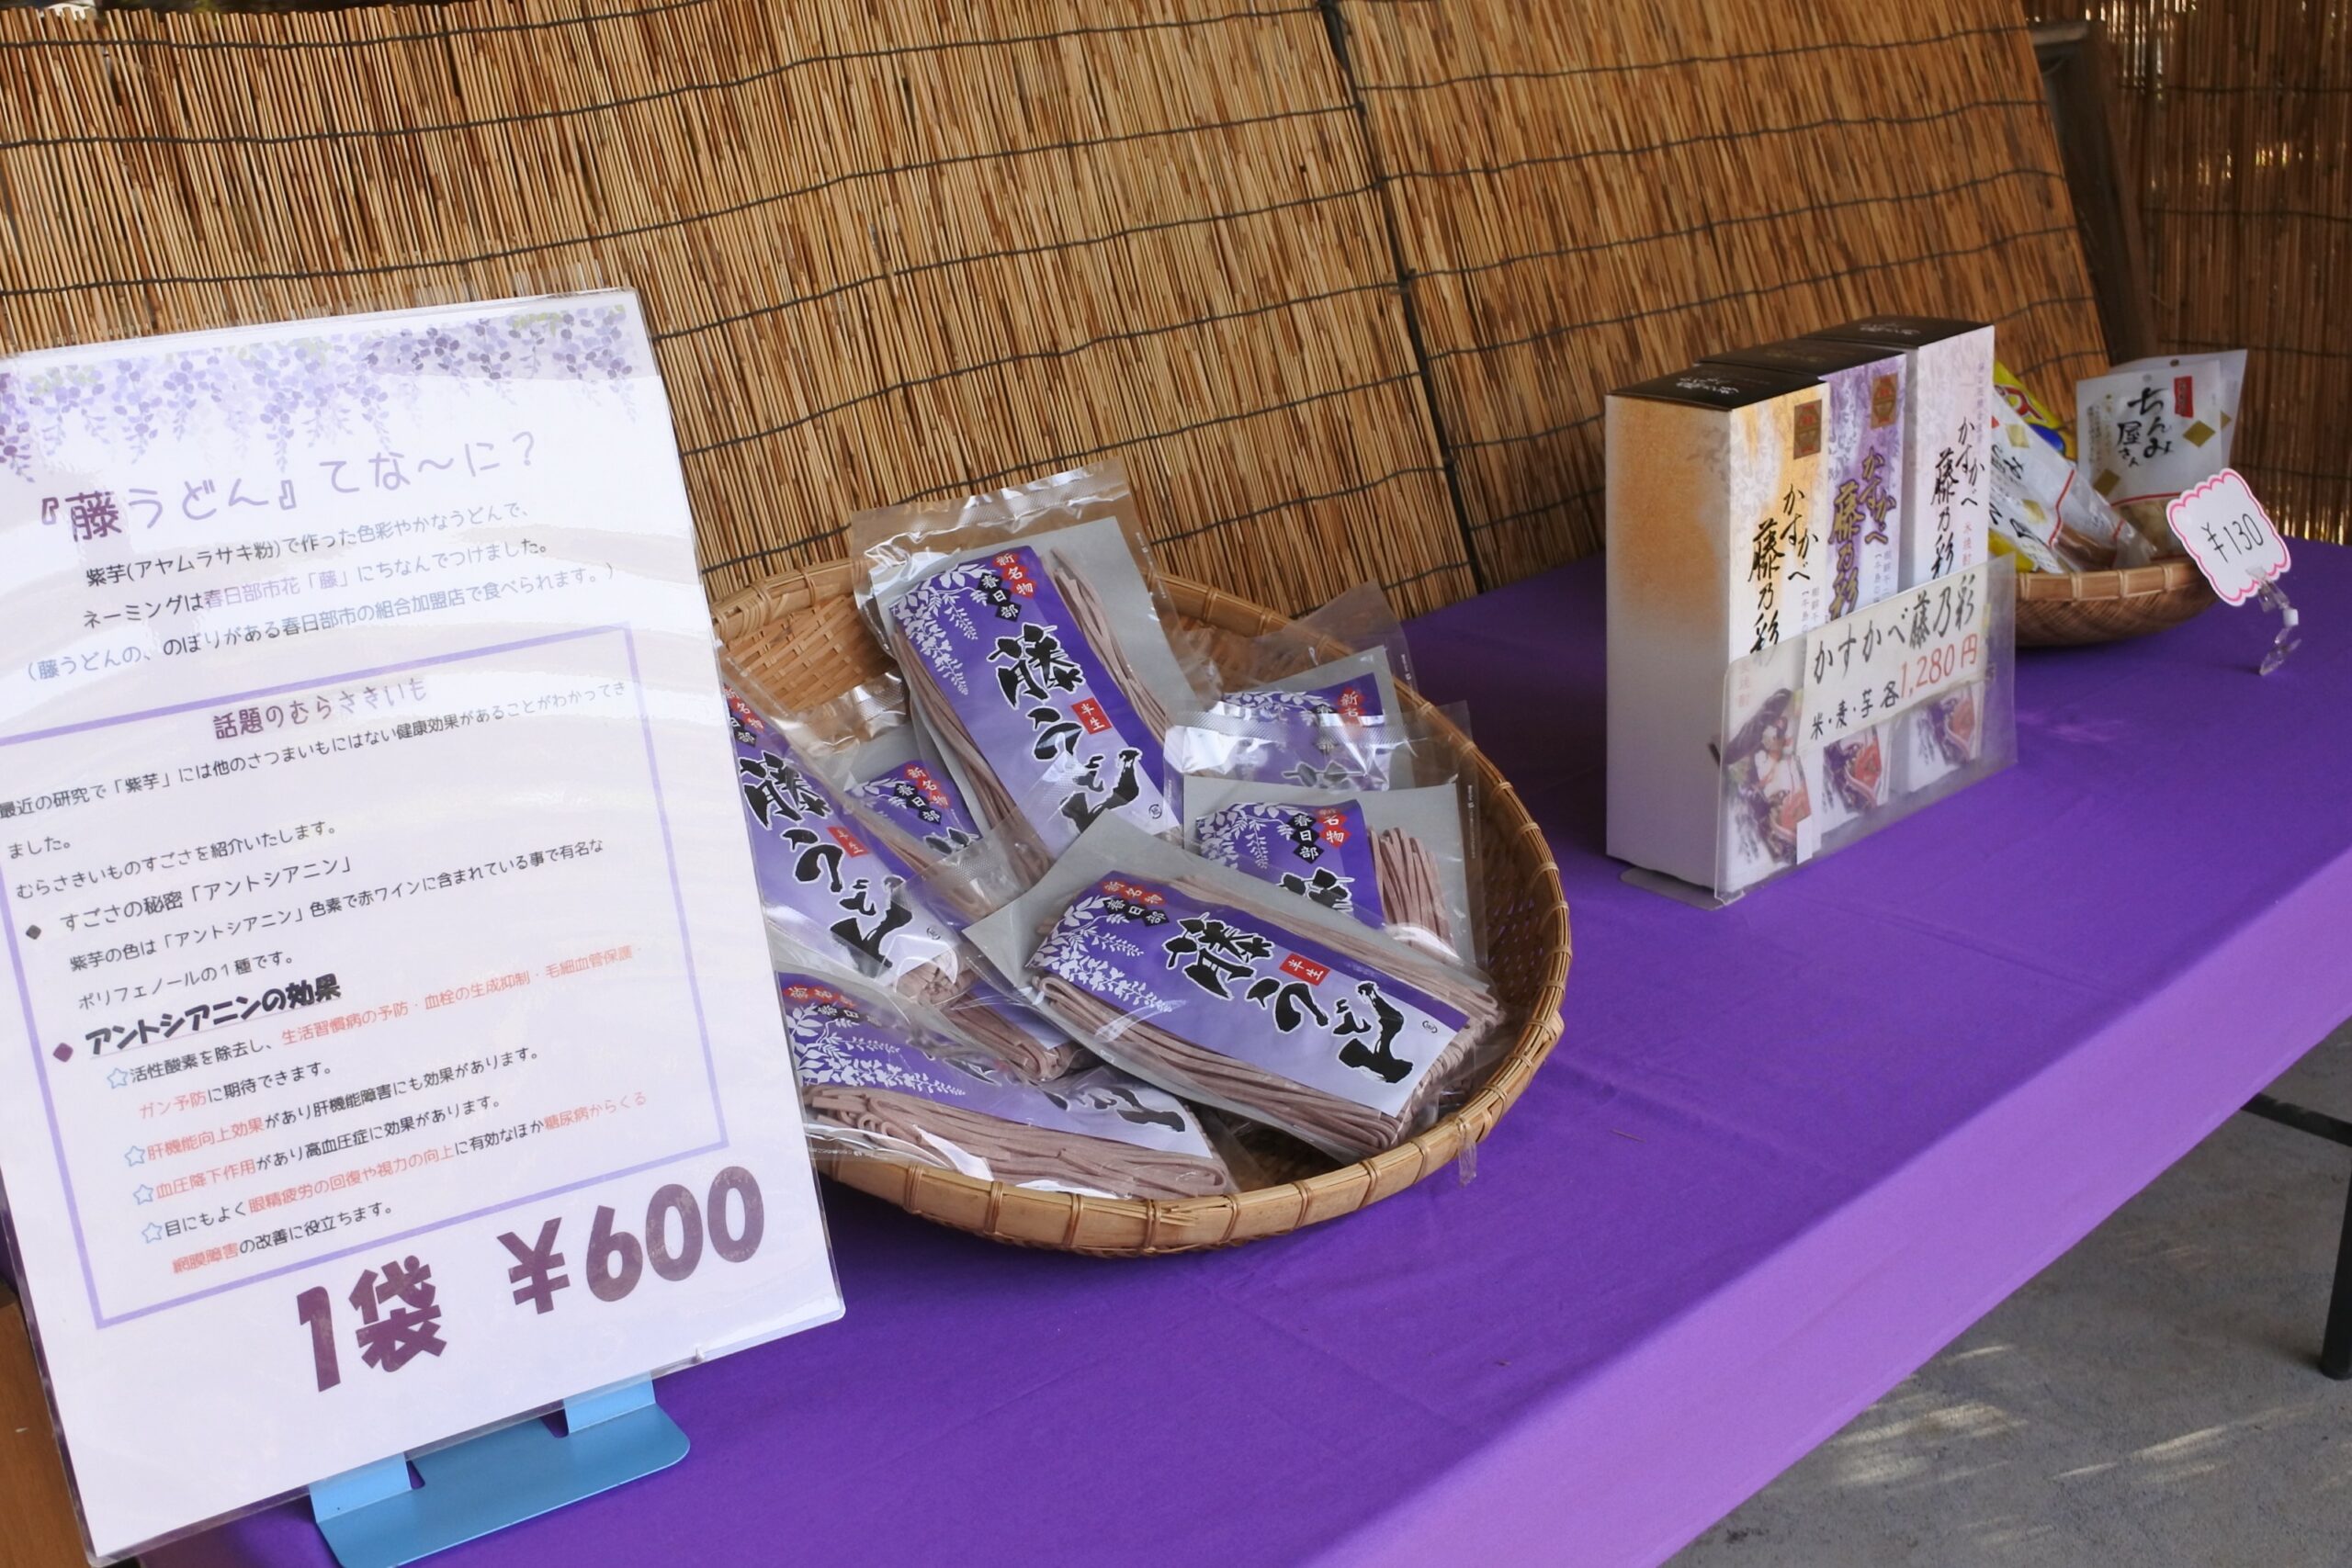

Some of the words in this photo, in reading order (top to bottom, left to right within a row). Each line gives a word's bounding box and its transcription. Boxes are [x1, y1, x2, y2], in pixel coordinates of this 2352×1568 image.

[2200, 513, 2265, 563] ¥130
[980, 574, 1019, 619] 春日部
[1899, 632, 1980, 700] 1,280円
[7, 835, 72, 860] ました。
[1294, 815, 1320, 861] 春日部
[1107, 898, 1167, 924] 春日部
[85, 973, 342, 1055] アントシアニンの効果
[296, 1254, 447, 1392] 1袋
[496, 1166, 764, 1315] ¥600
